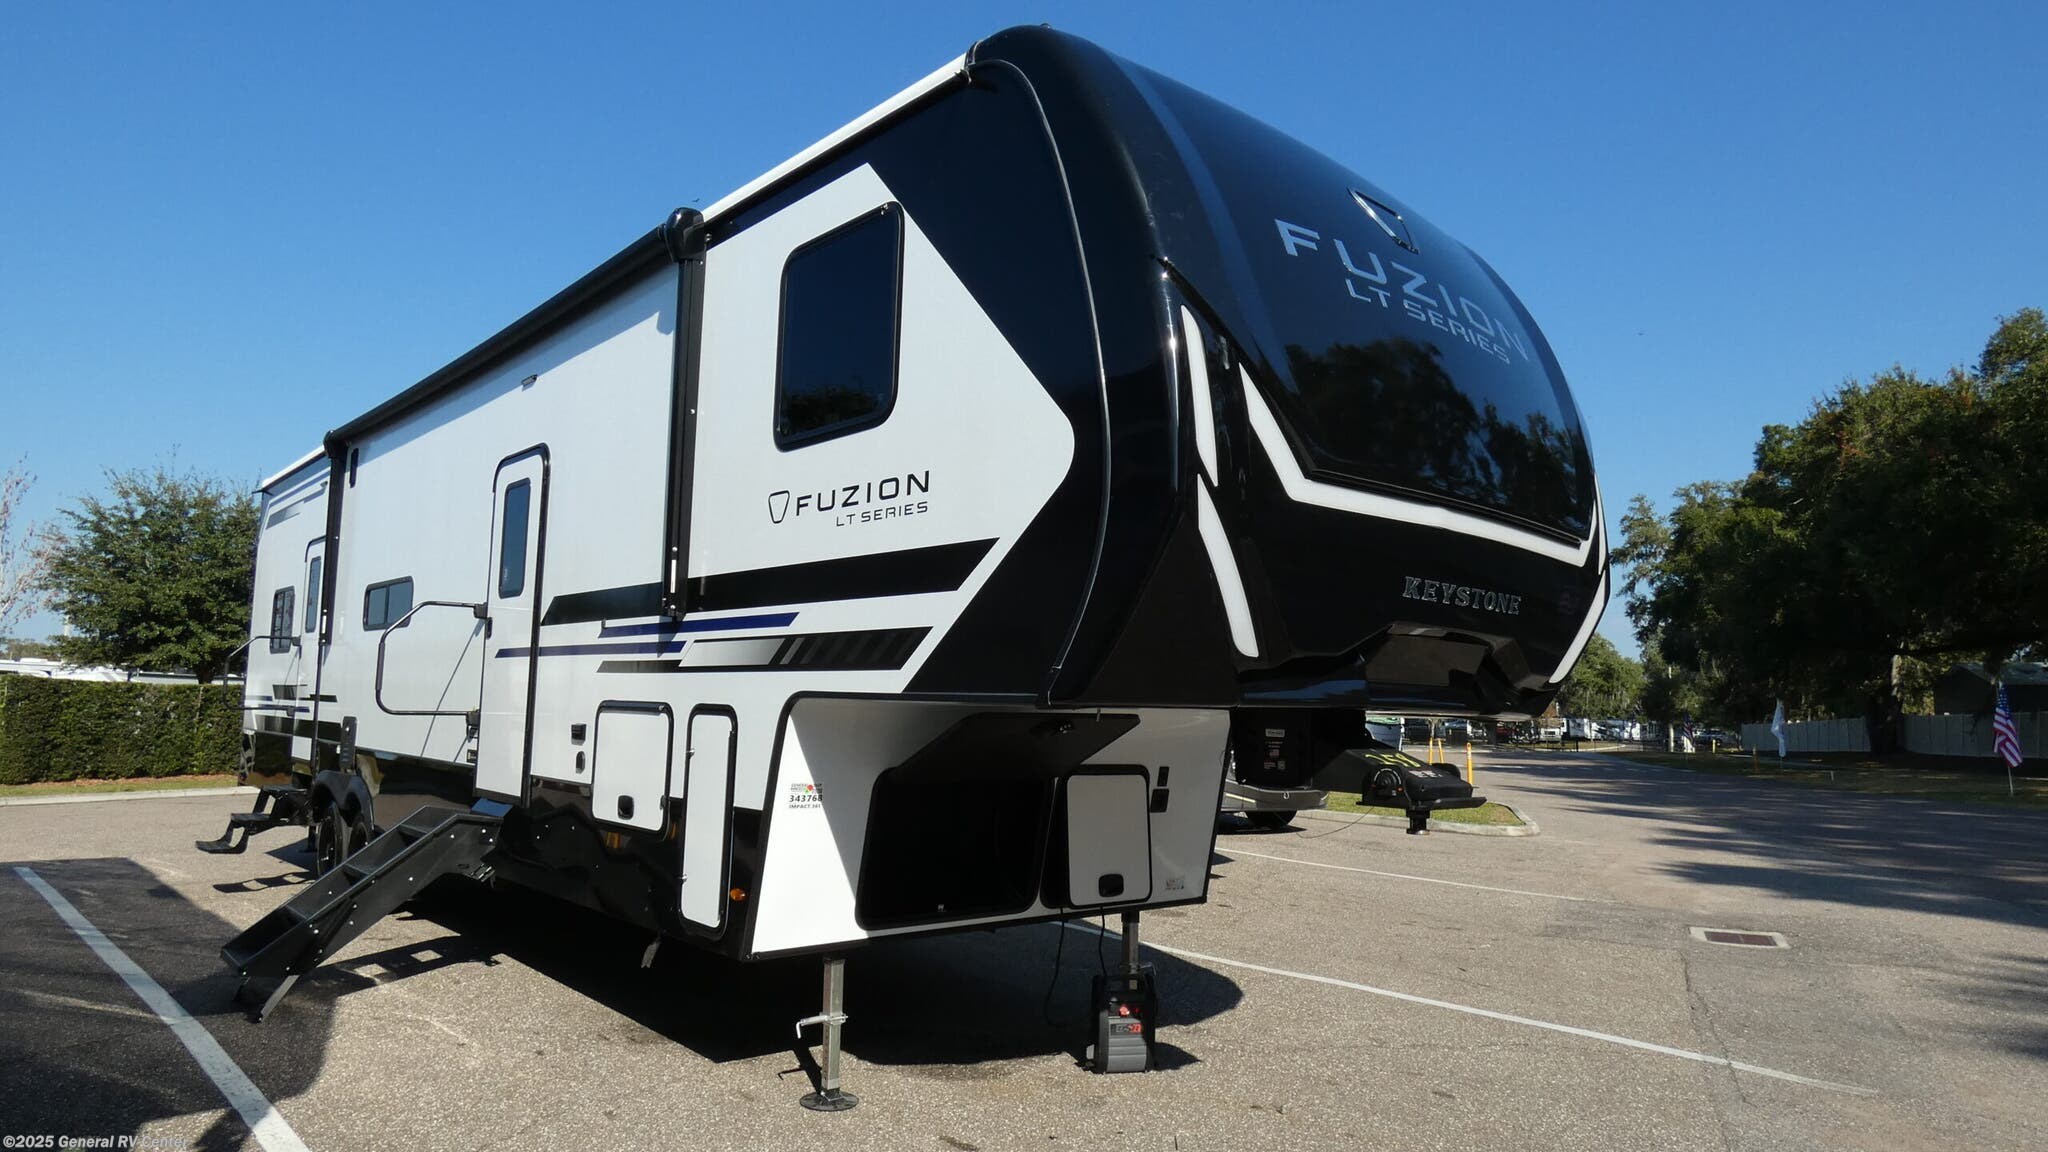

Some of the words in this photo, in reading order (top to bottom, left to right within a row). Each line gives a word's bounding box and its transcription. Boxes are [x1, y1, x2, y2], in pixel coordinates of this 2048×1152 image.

[1274, 218, 1529, 361] FUZION
[1345, 278, 1391, 308] LT
[1402, 298, 1511, 365] SERIES
[795, 470, 930, 516] FUZION
[836, 513, 856, 527] LT
[861, 501, 928, 523] SERIES
[1402, 576, 1522, 615] KEYSTONE
